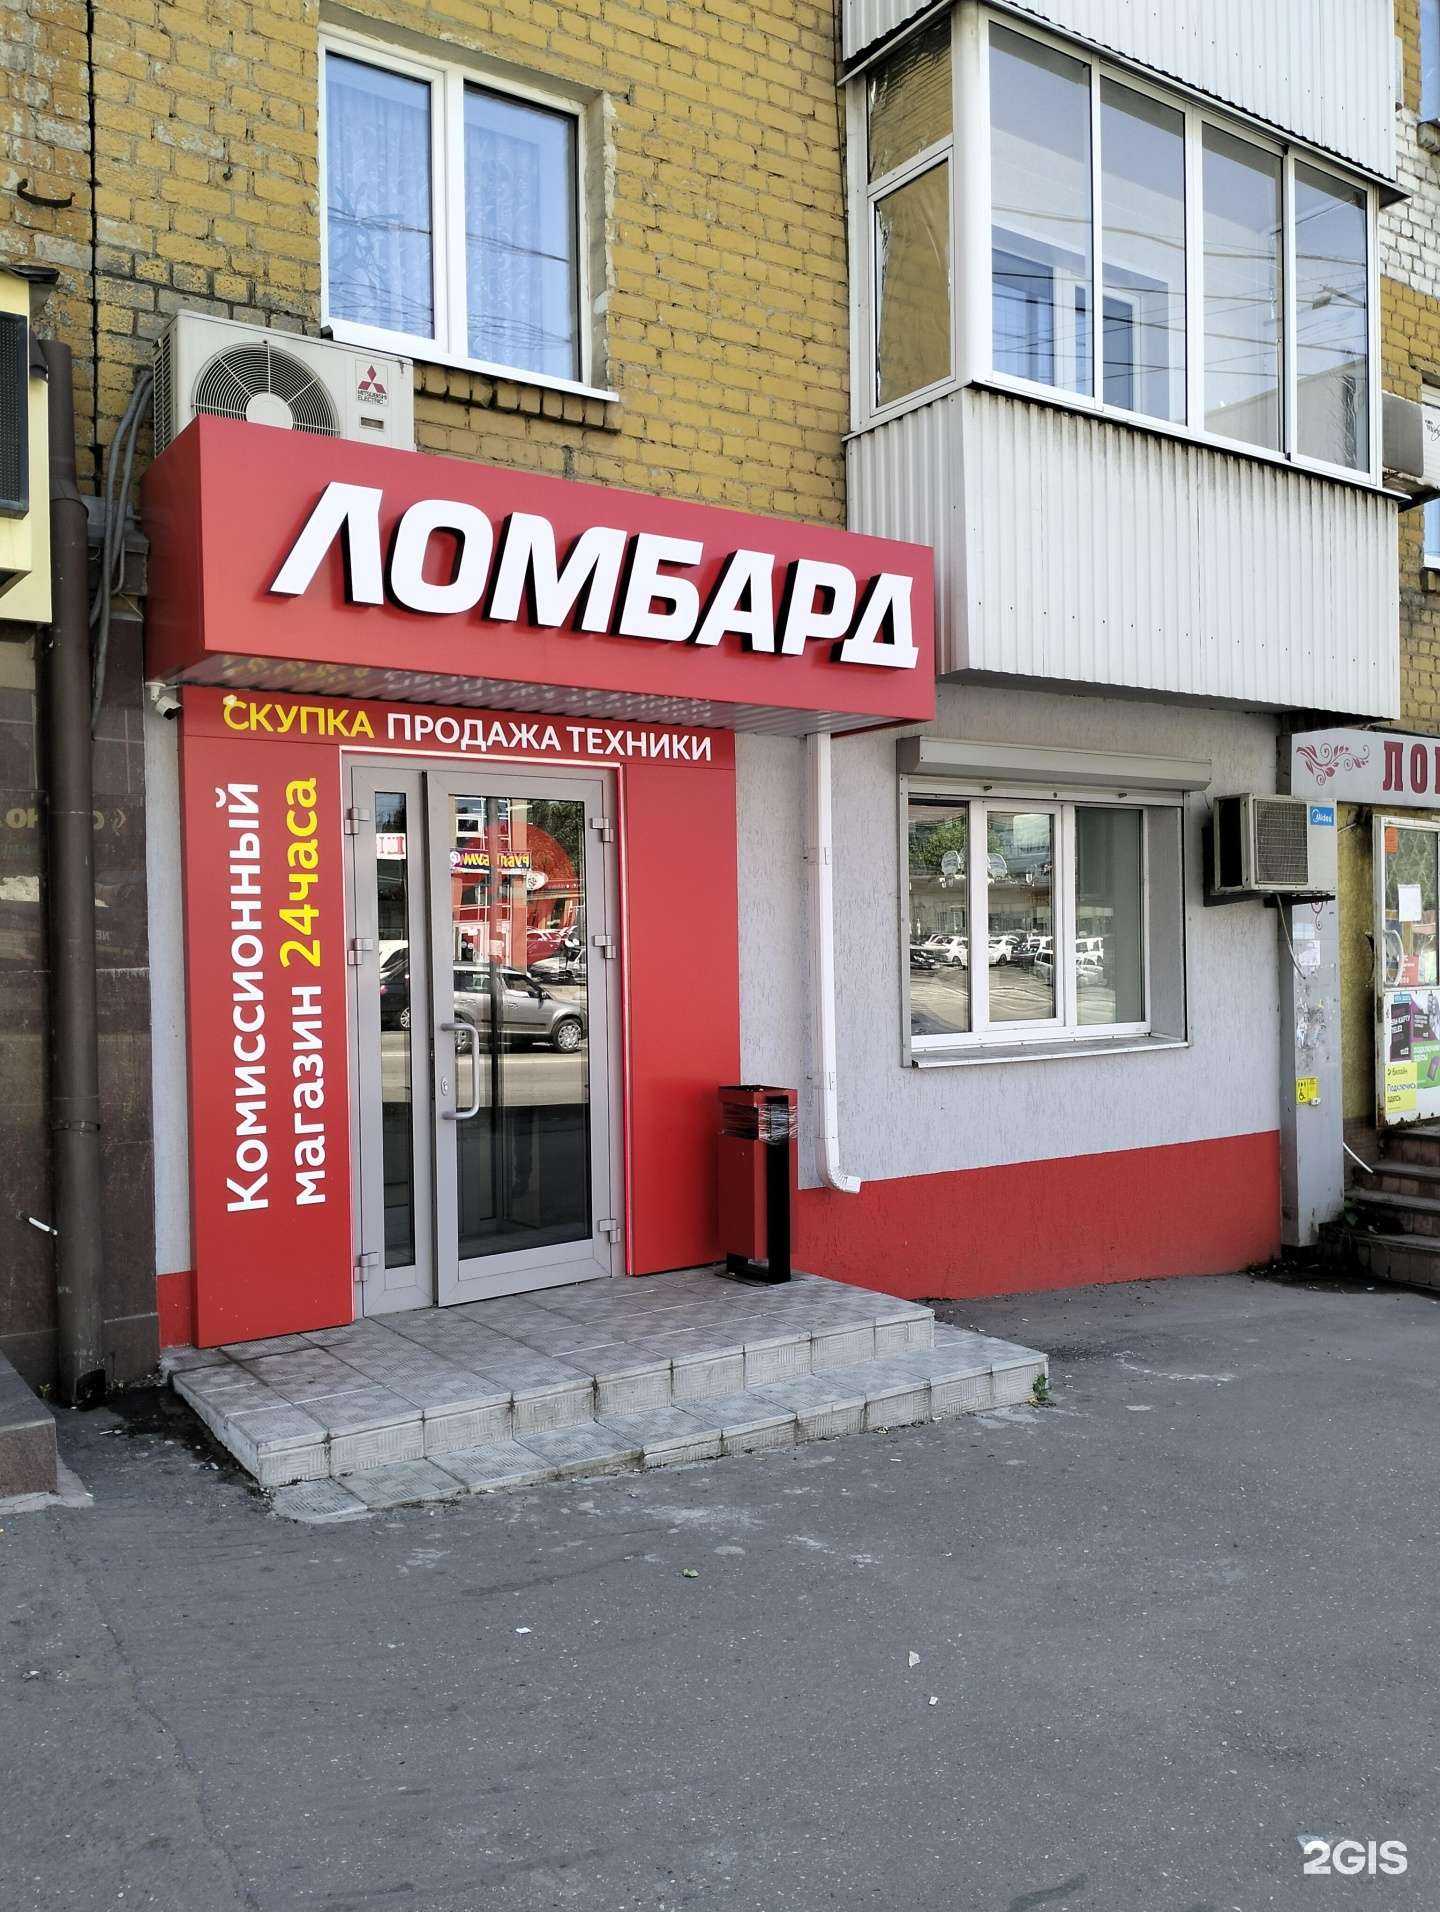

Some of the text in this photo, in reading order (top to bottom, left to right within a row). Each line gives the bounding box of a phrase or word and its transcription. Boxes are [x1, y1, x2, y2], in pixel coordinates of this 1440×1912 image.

[269, 481, 919, 669] ЛОМБАРД
[223, 695, 712, 762] СКУПКА ПРОДАЖА ТЕХНИКИ
[1382, 741, 1440, 795] ЛО
[215, 783, 269, 1212] Комиссионный
[291, 985, 326, 1206] магазин
